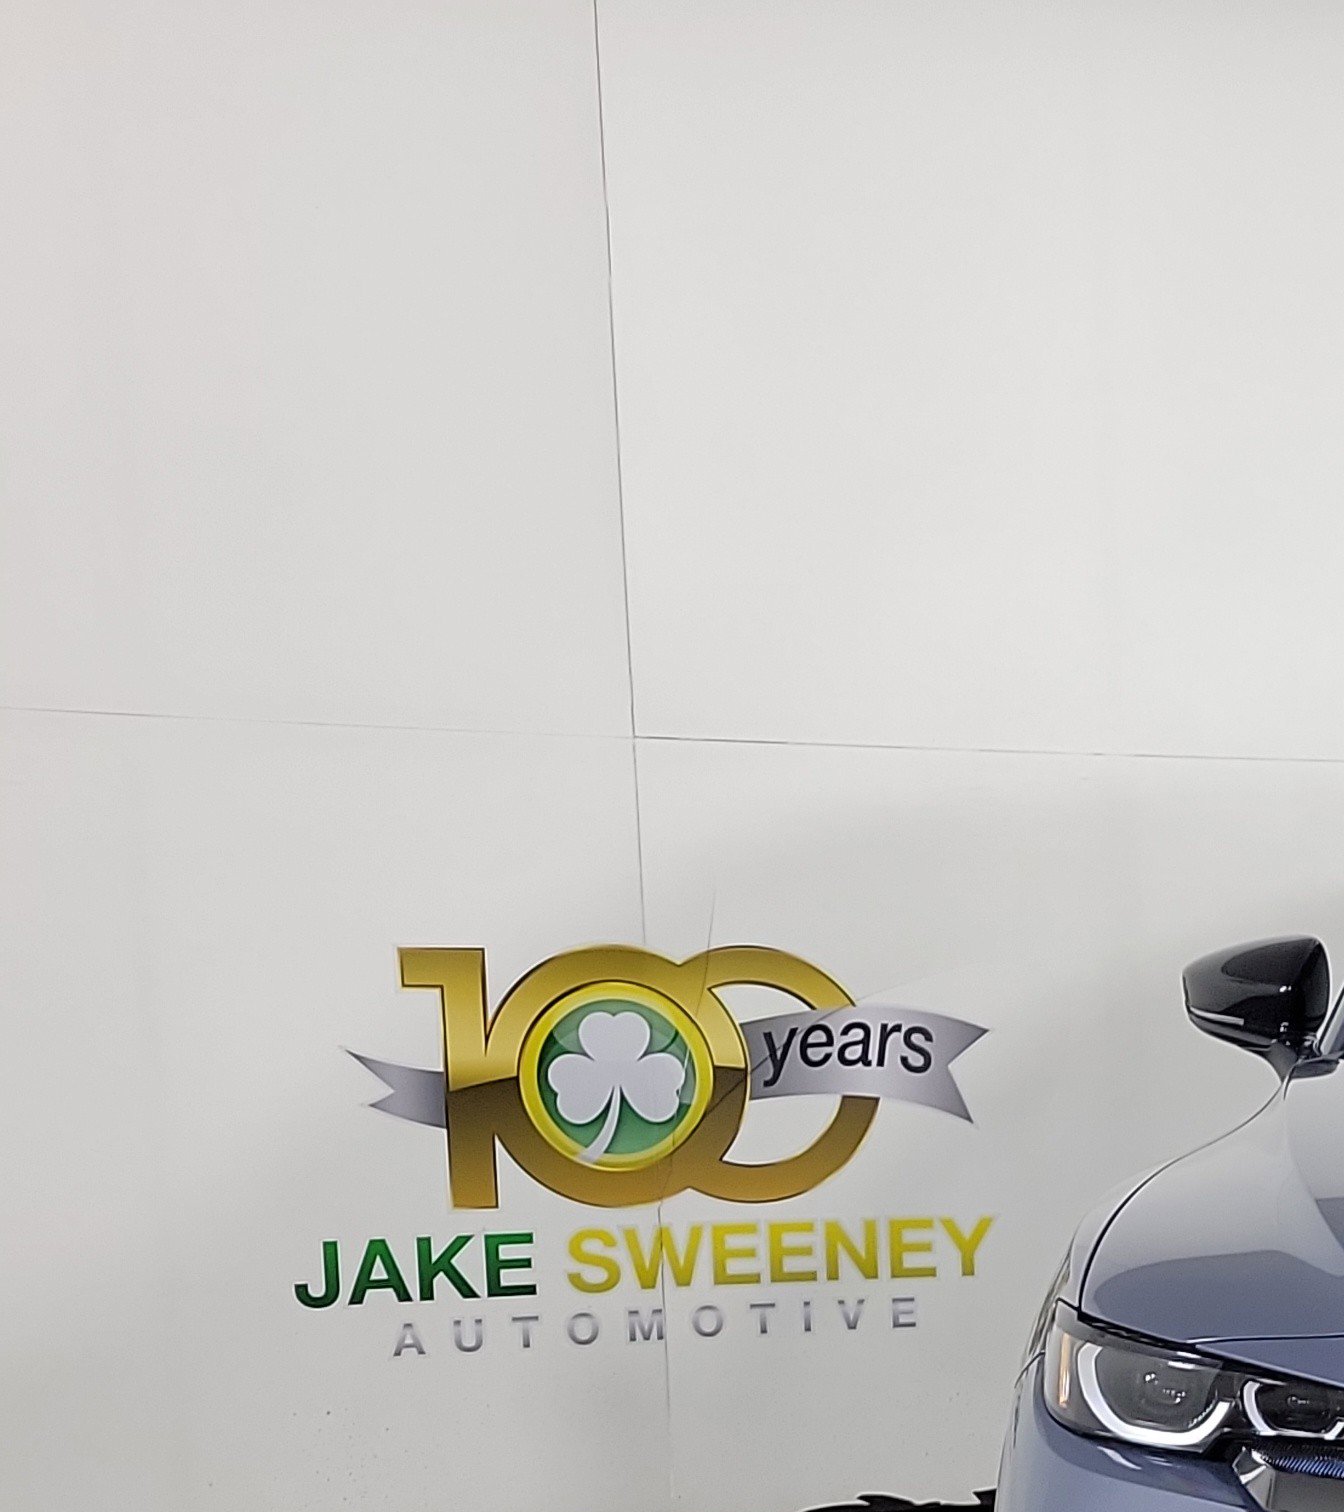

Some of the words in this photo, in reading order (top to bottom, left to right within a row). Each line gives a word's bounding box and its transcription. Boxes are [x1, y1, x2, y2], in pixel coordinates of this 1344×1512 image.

[398, 944, 880, 1210] 100
[762, 1020, 934, 1087] years
[294, 1232, 538, 1310] JAKE
[566, 1217, 993, 1294] SWEENEY
[393, 1297, 918, 1358] AUTOMOTIVE
